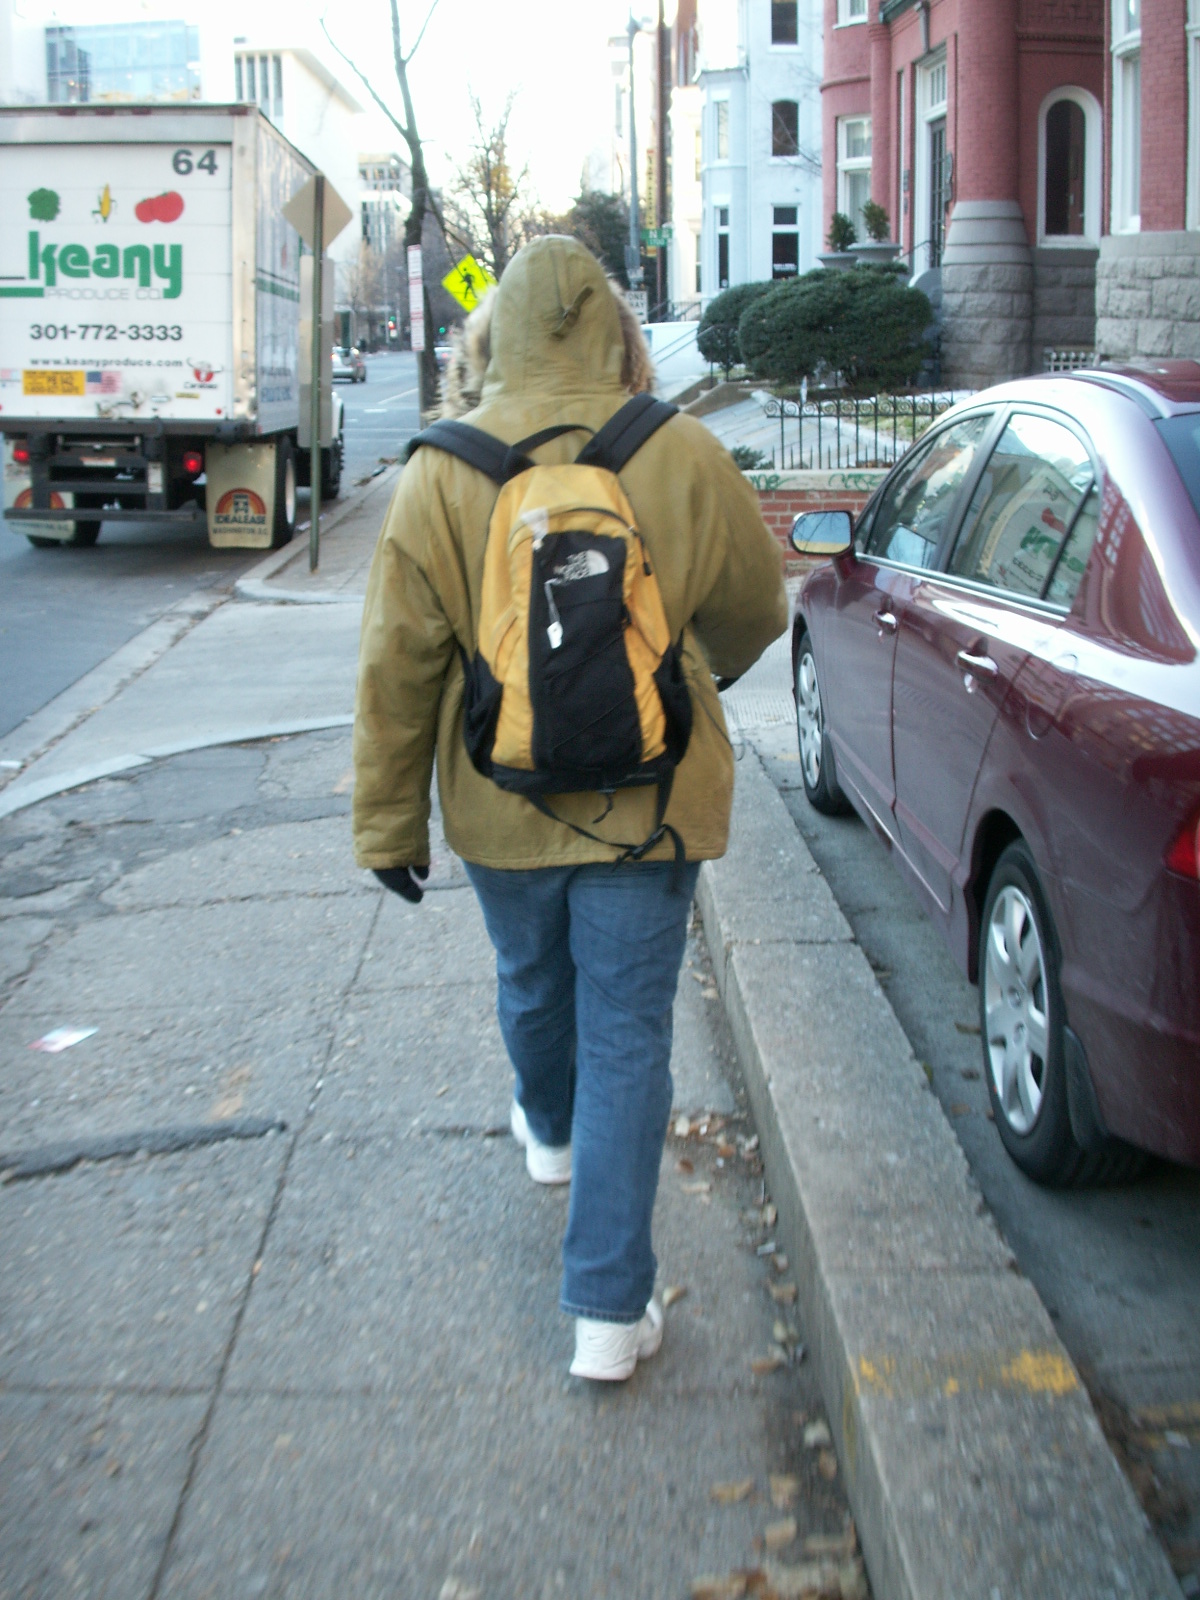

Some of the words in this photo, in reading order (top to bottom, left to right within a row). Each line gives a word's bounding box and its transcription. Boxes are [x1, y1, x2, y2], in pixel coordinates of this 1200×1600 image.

[172, 149, 218, 176] 64
[28, 230, 183, 299] keany
[45, 287, 130, 300] PRODUCE
[628, 292, 644, 300] ONE
[30, 325, 183, 341] 301-772-3333
[30, 357, 183, 369] www.keanyproduce.com
[215, 514, 266, 524] IDEALEASE
